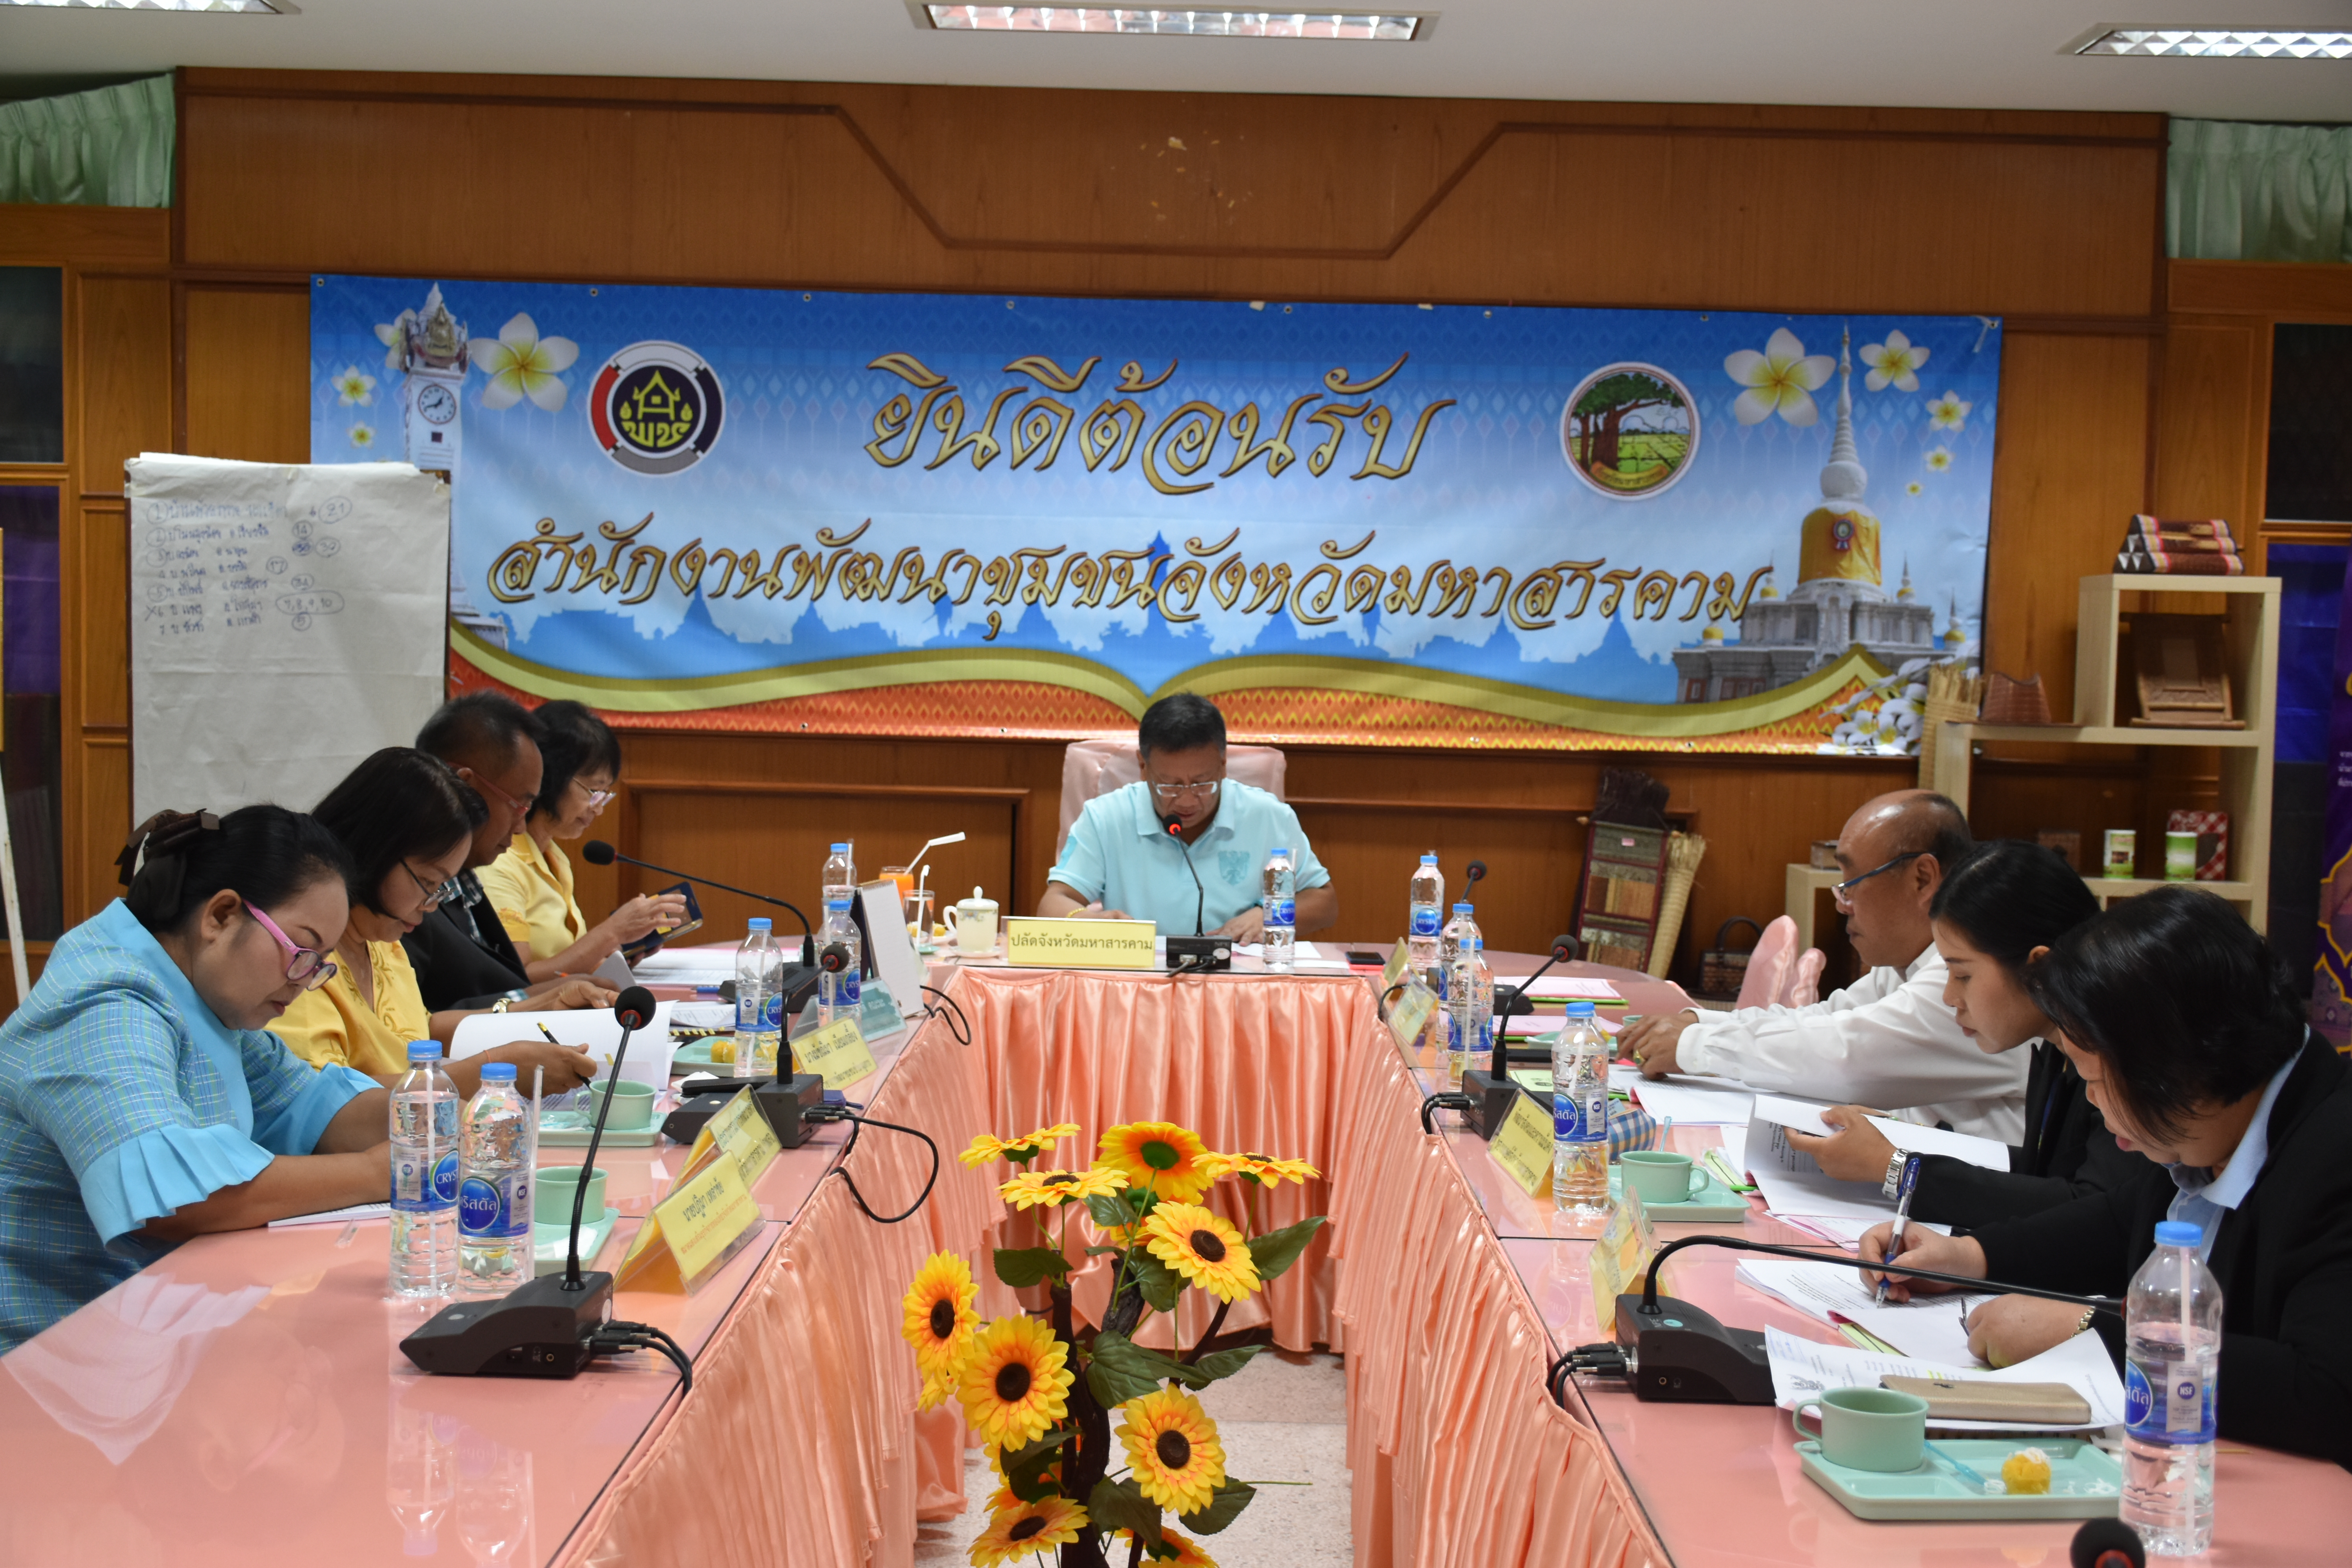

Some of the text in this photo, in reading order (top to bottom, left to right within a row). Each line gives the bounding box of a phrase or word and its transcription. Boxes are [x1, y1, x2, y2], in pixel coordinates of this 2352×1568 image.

[864, 352, 1456, 495] ยินดีต้อนรับ
[487, 511, 1774, 641] สำนักงานพัฒนาชุมชนจังหวัดมหาสารคาม
[1011, 932, 1153, 950] ปลัดจังหวัดมหาสารคาม
[518, 1188, 526, 1196] NSF
[2180, 1386, 2193, 1396] NSF
